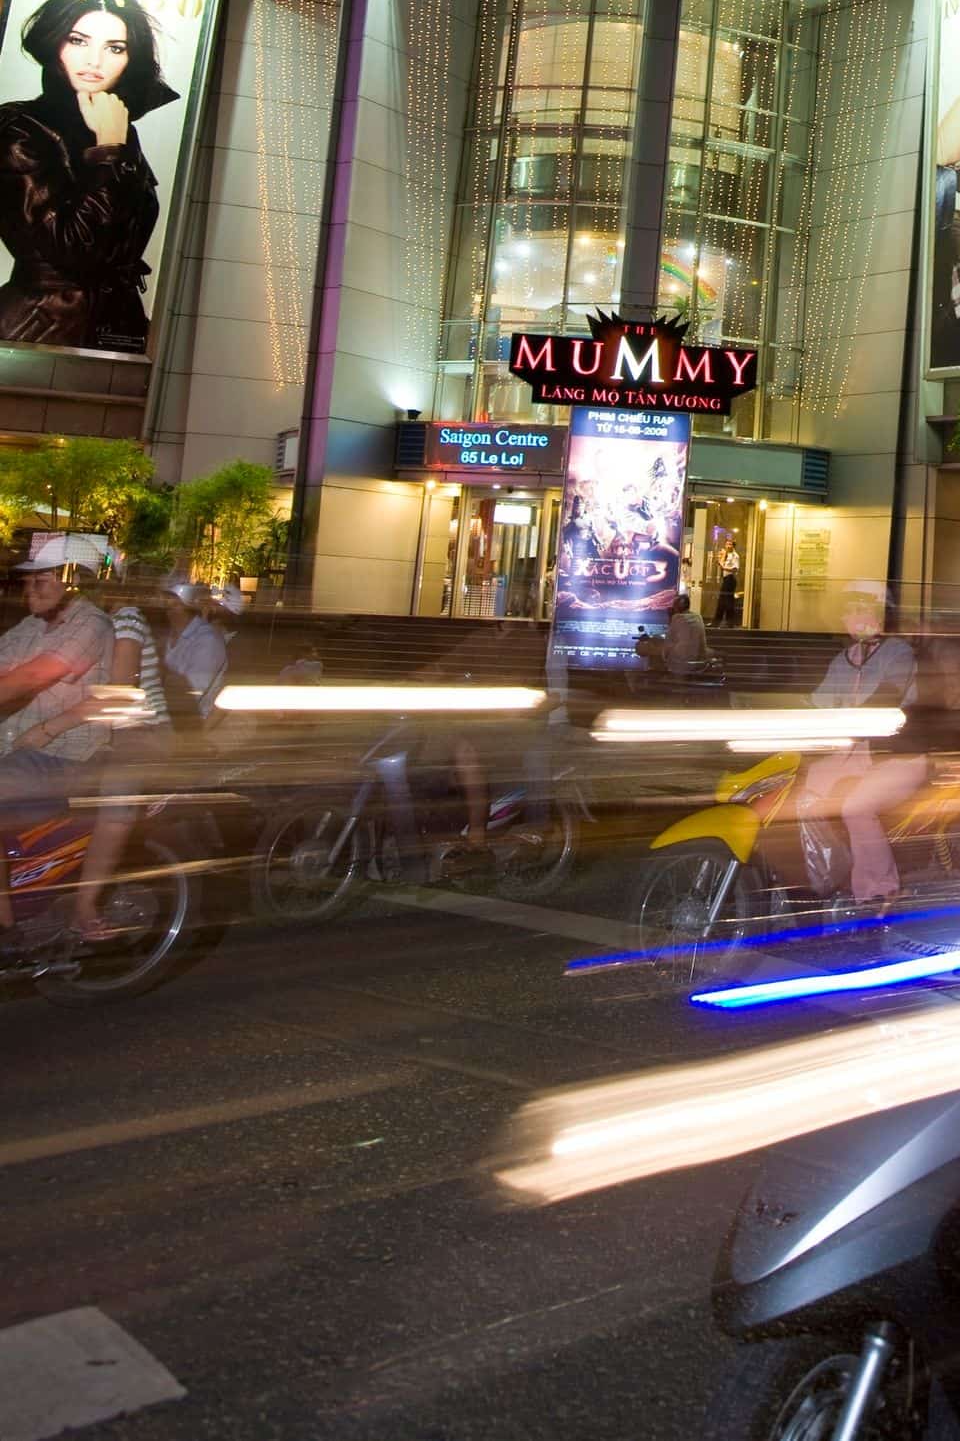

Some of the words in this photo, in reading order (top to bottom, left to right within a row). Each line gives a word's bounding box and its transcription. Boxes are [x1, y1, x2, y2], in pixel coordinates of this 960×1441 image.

[513, 335, 754, 385] MUMMY
[440, 428, 491, 448] Saigon
[495, 430, 549, 447] Centre
[461, 451, 478, 464] 65
[480, 451, 498, 464] Le
[501, 452, 524, 465] Loi
[553, 648, 640, 658] MEGASTA
